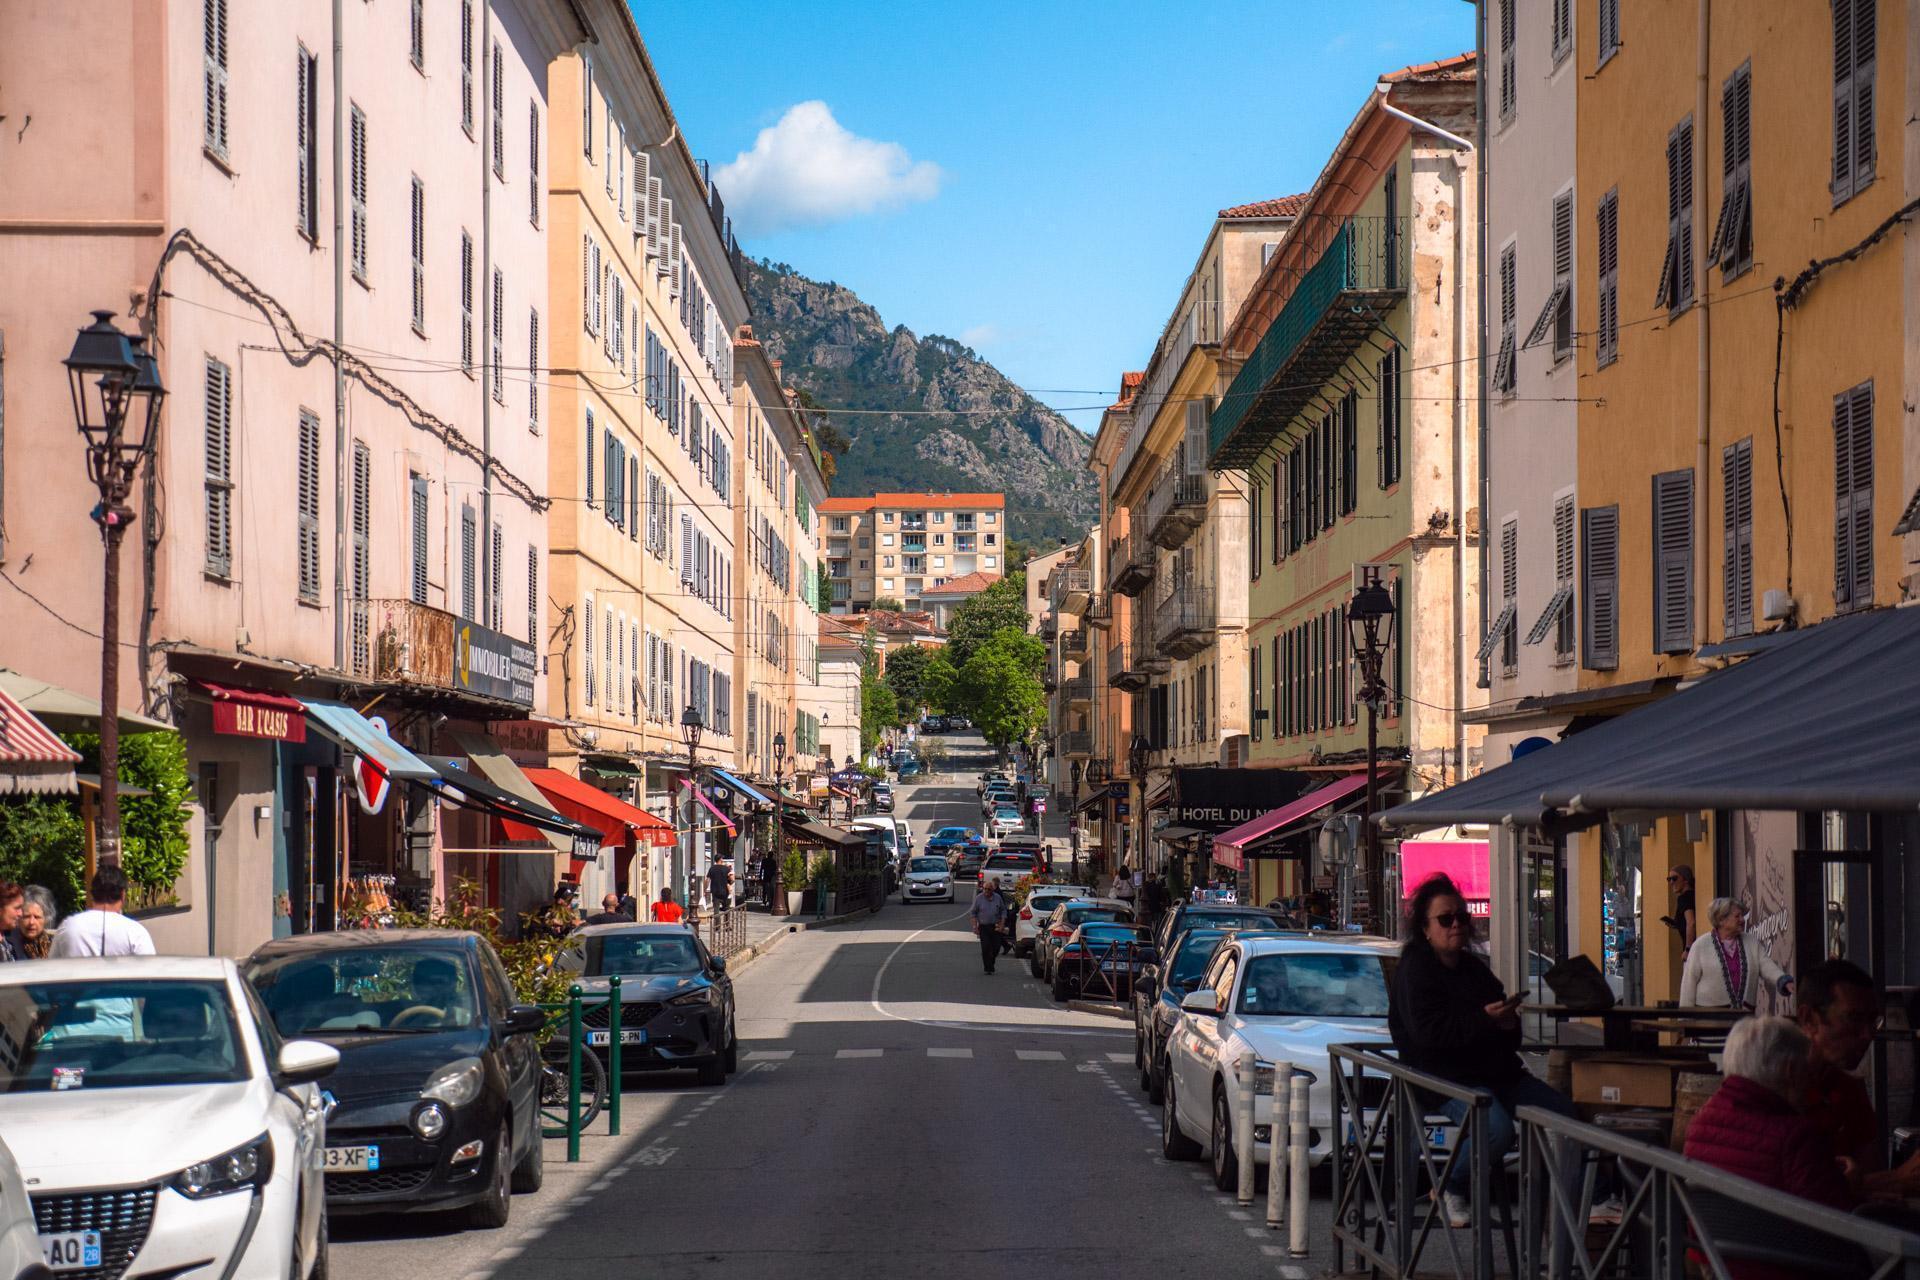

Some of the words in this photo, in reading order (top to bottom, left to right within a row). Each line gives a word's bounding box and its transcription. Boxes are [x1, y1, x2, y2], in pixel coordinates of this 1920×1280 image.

[468, 644, 511, 682] IMMOBILIER
[236, 704, 254, 732] BAR
[1182, 807, 1226, 821] HOTEL
[1230, 808, 1251, 821] DU
